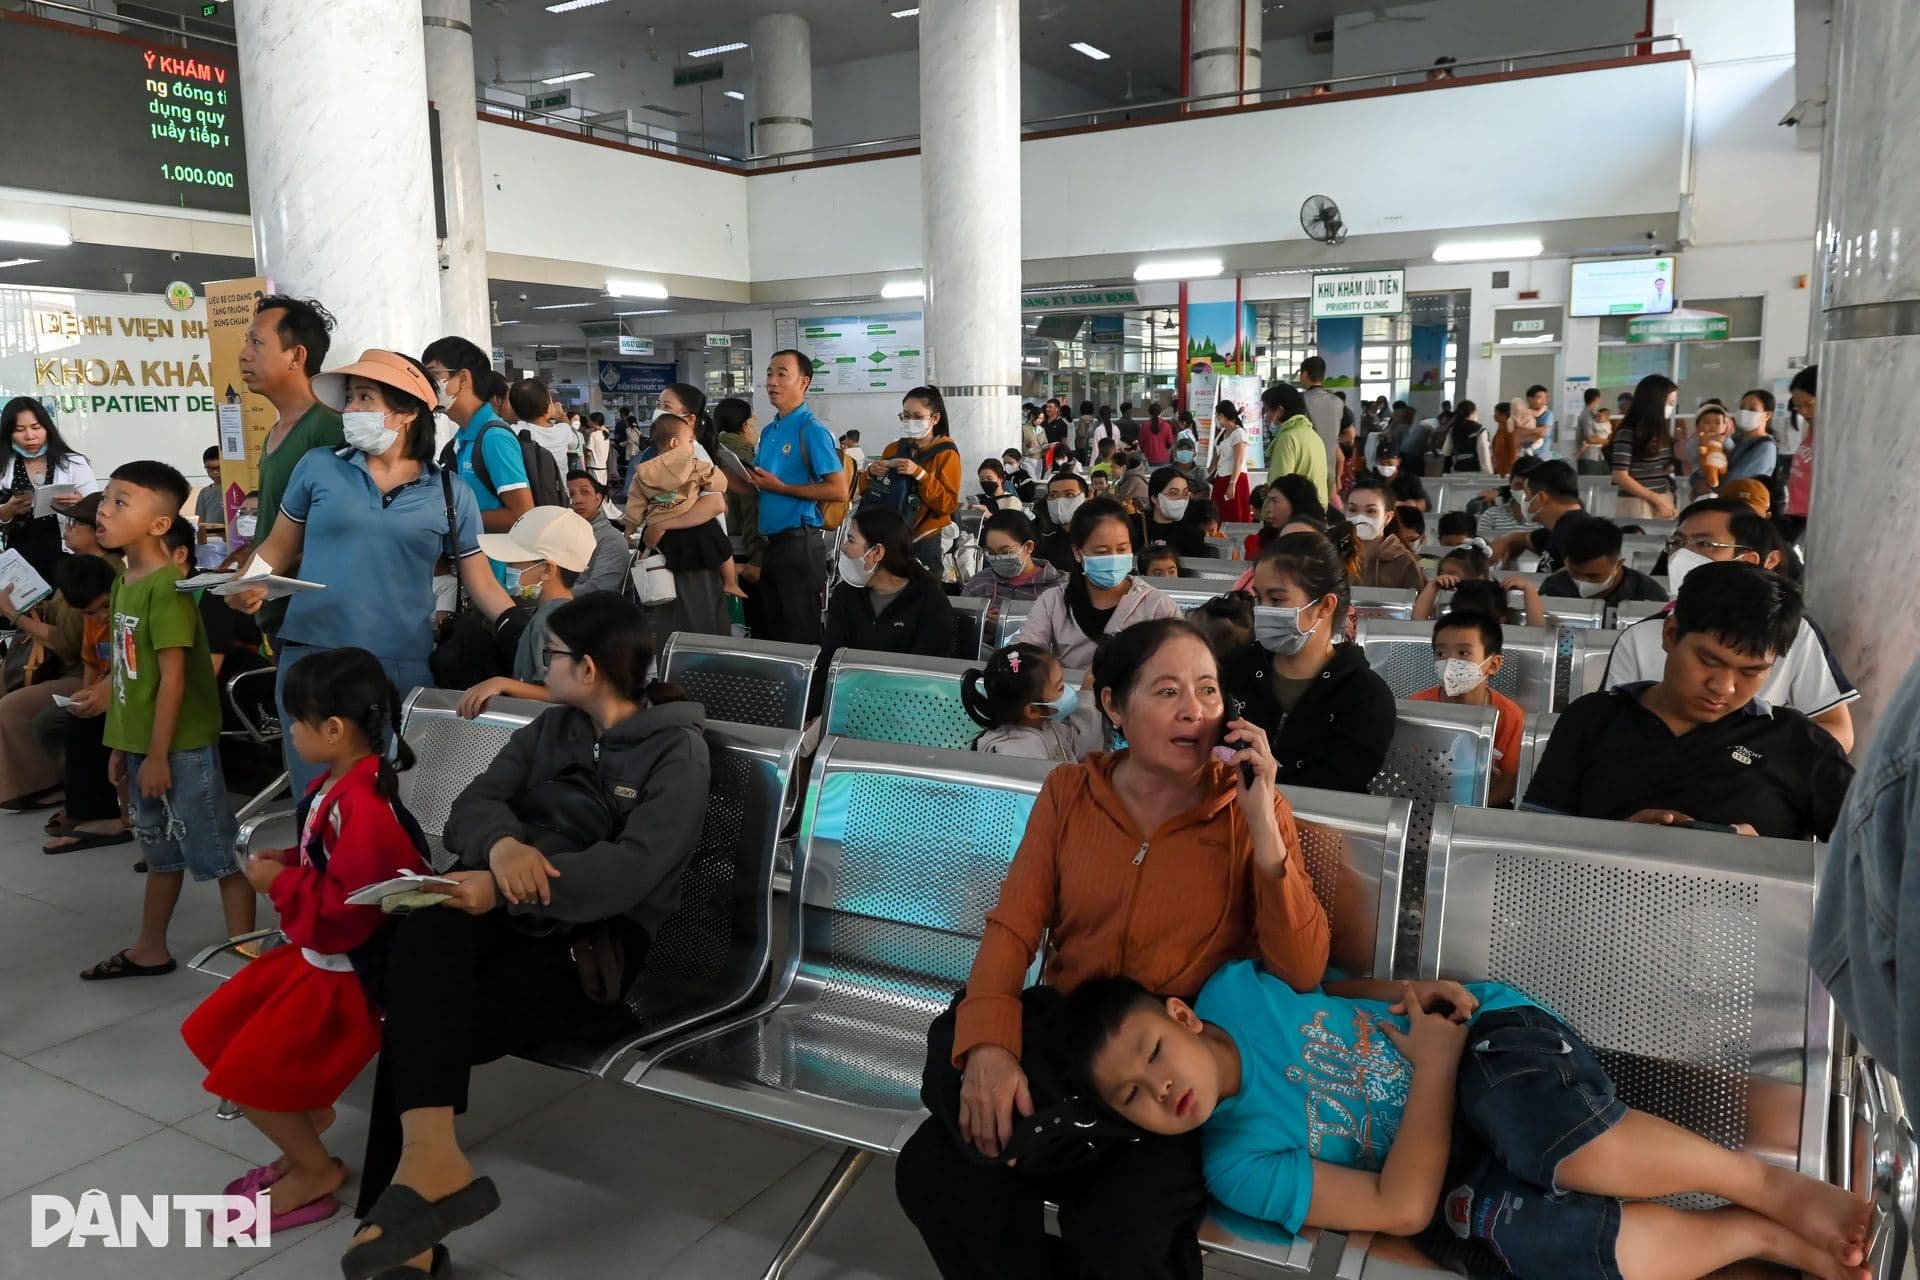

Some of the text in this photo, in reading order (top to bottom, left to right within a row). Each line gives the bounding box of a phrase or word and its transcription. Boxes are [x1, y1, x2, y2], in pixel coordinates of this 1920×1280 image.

[160, 56, 211, 81] KHÁM
[172, 81, 214, 106] đóng
[149, 99, 225, 129] dụng quy
[189, 125, 220, 148] tiếp
[161, 164, 234, 188] 1.000.000
[1318, 281, 1335, 298] KHU
[1337, 277, 1362, 297] KHÁM
[1326, 300, 1390, 312] PRIORITY CLINIC
[40, 311, 113, 339] BỆNH
[118, 317, 174, 342] VIỆN
[34, 354, 214, 387] KHOA KHÁ
[187, 396, 215, 413] DE
